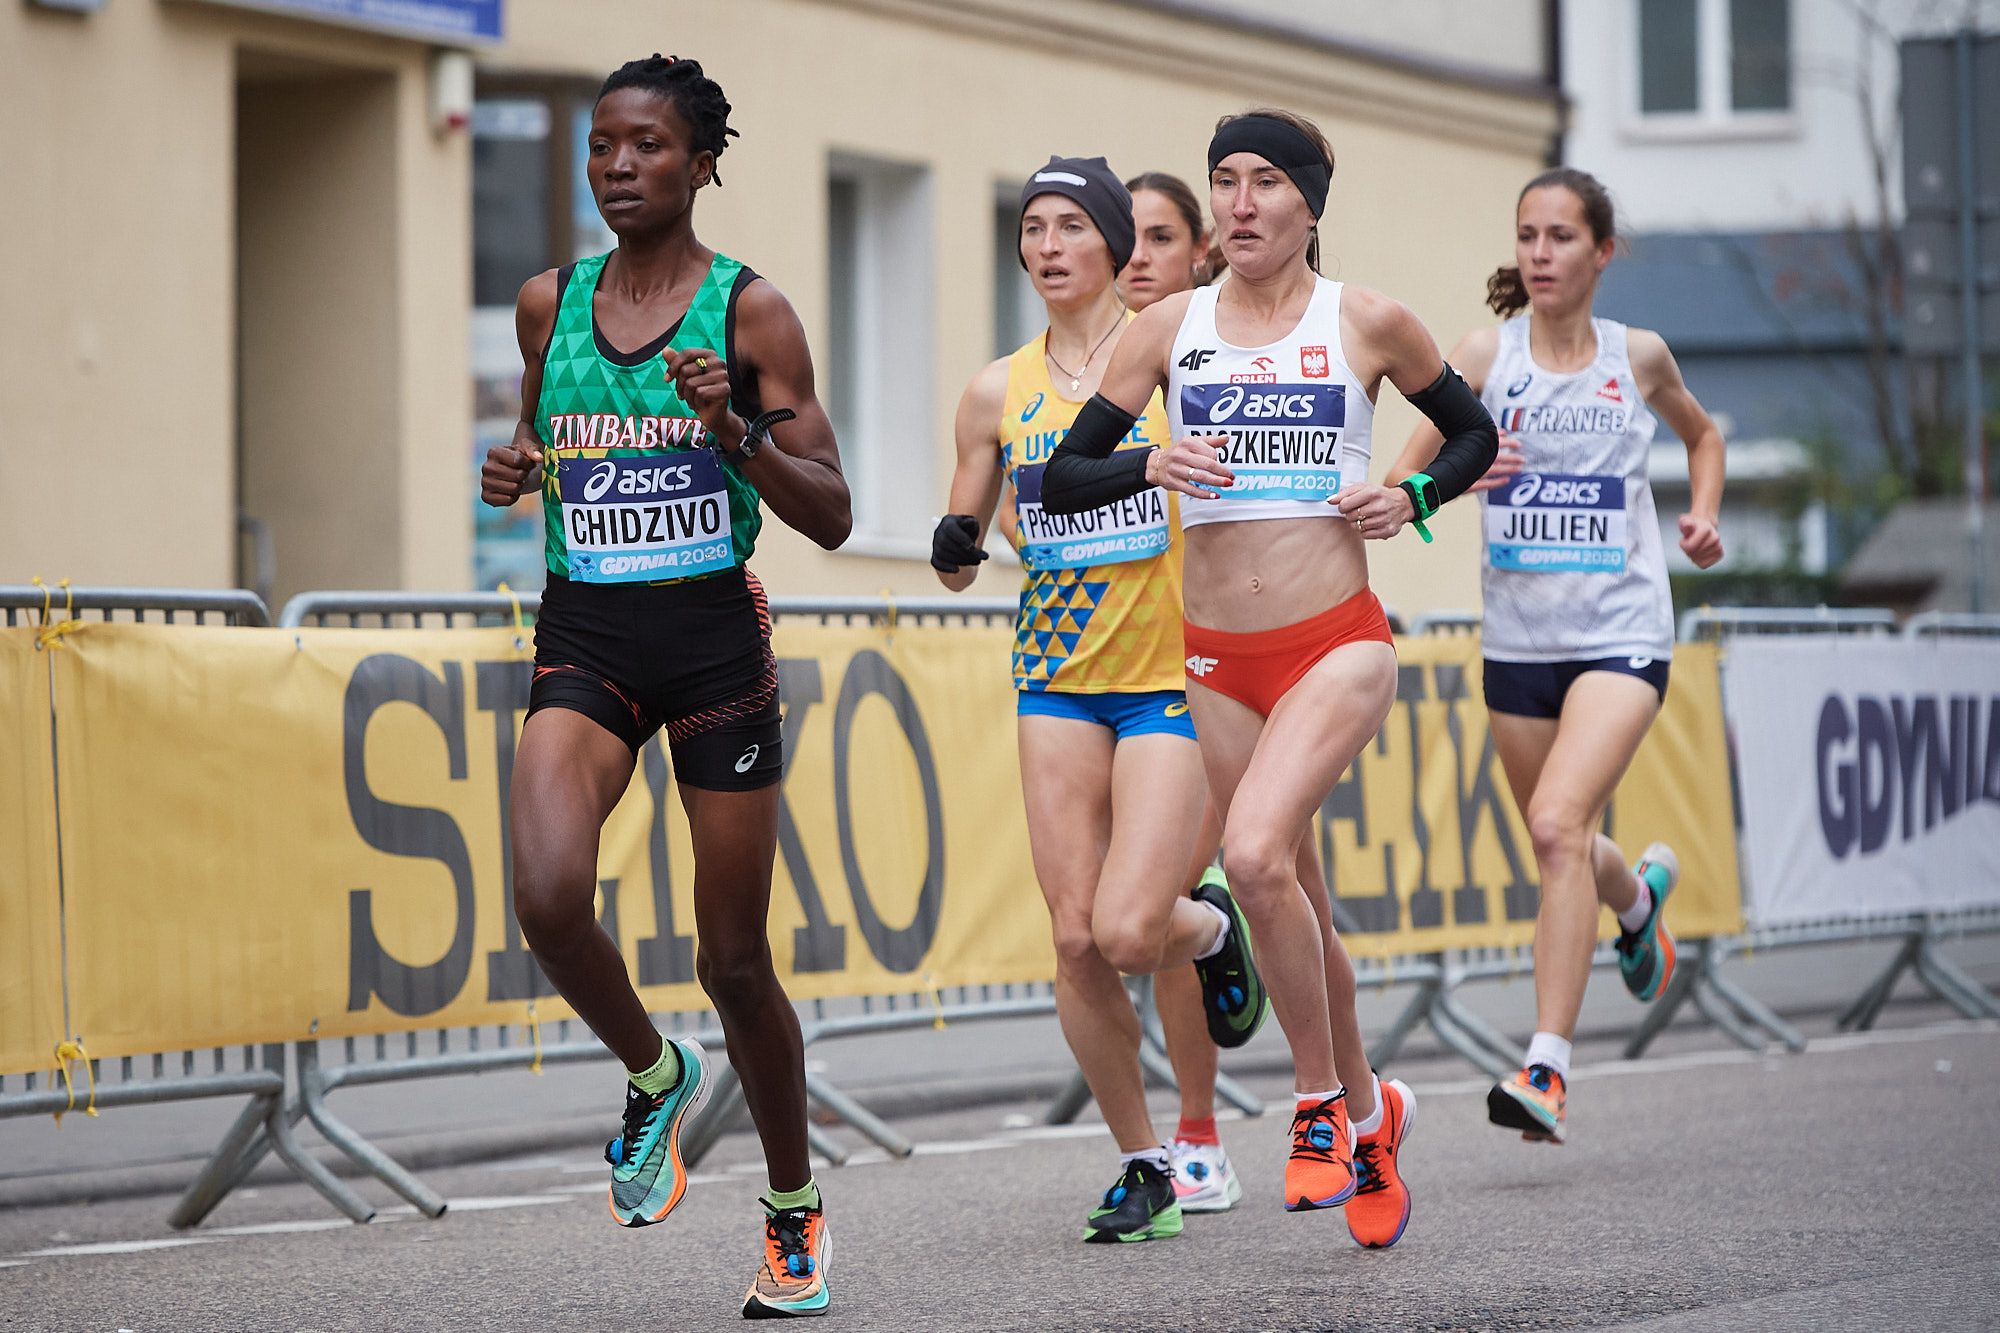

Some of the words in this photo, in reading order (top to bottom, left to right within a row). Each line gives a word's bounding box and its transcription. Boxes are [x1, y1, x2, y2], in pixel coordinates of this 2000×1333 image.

[1178, 349, 1216, 371] 4F
[1231, 374, 1274, 384] ORLEN
[1243, 393, 1315, 418] asics
[1520, 405, 1627, 436] FRANCE
[1190, 430, 1338, 465] SZKIEWICZ
[618, 464, 692, 495] asics
[1294, 475, 1337, 490] 2020
[1539, 481, 1602, 505] asics
[571, 497, 721, 546] CHIDZIVO
[1503, 511, 1608, 542] JULIEN
[600, 552, 678, 575] GDYNIA
[680, 543, 728, 566] 2020
[1062, 539, 1127, 562] GDYNIA
[1128, 531, 1167, 551] 2020
[1582, 550, 1622, 566] 2020
[1185, 654, 1219, 677] 4F
